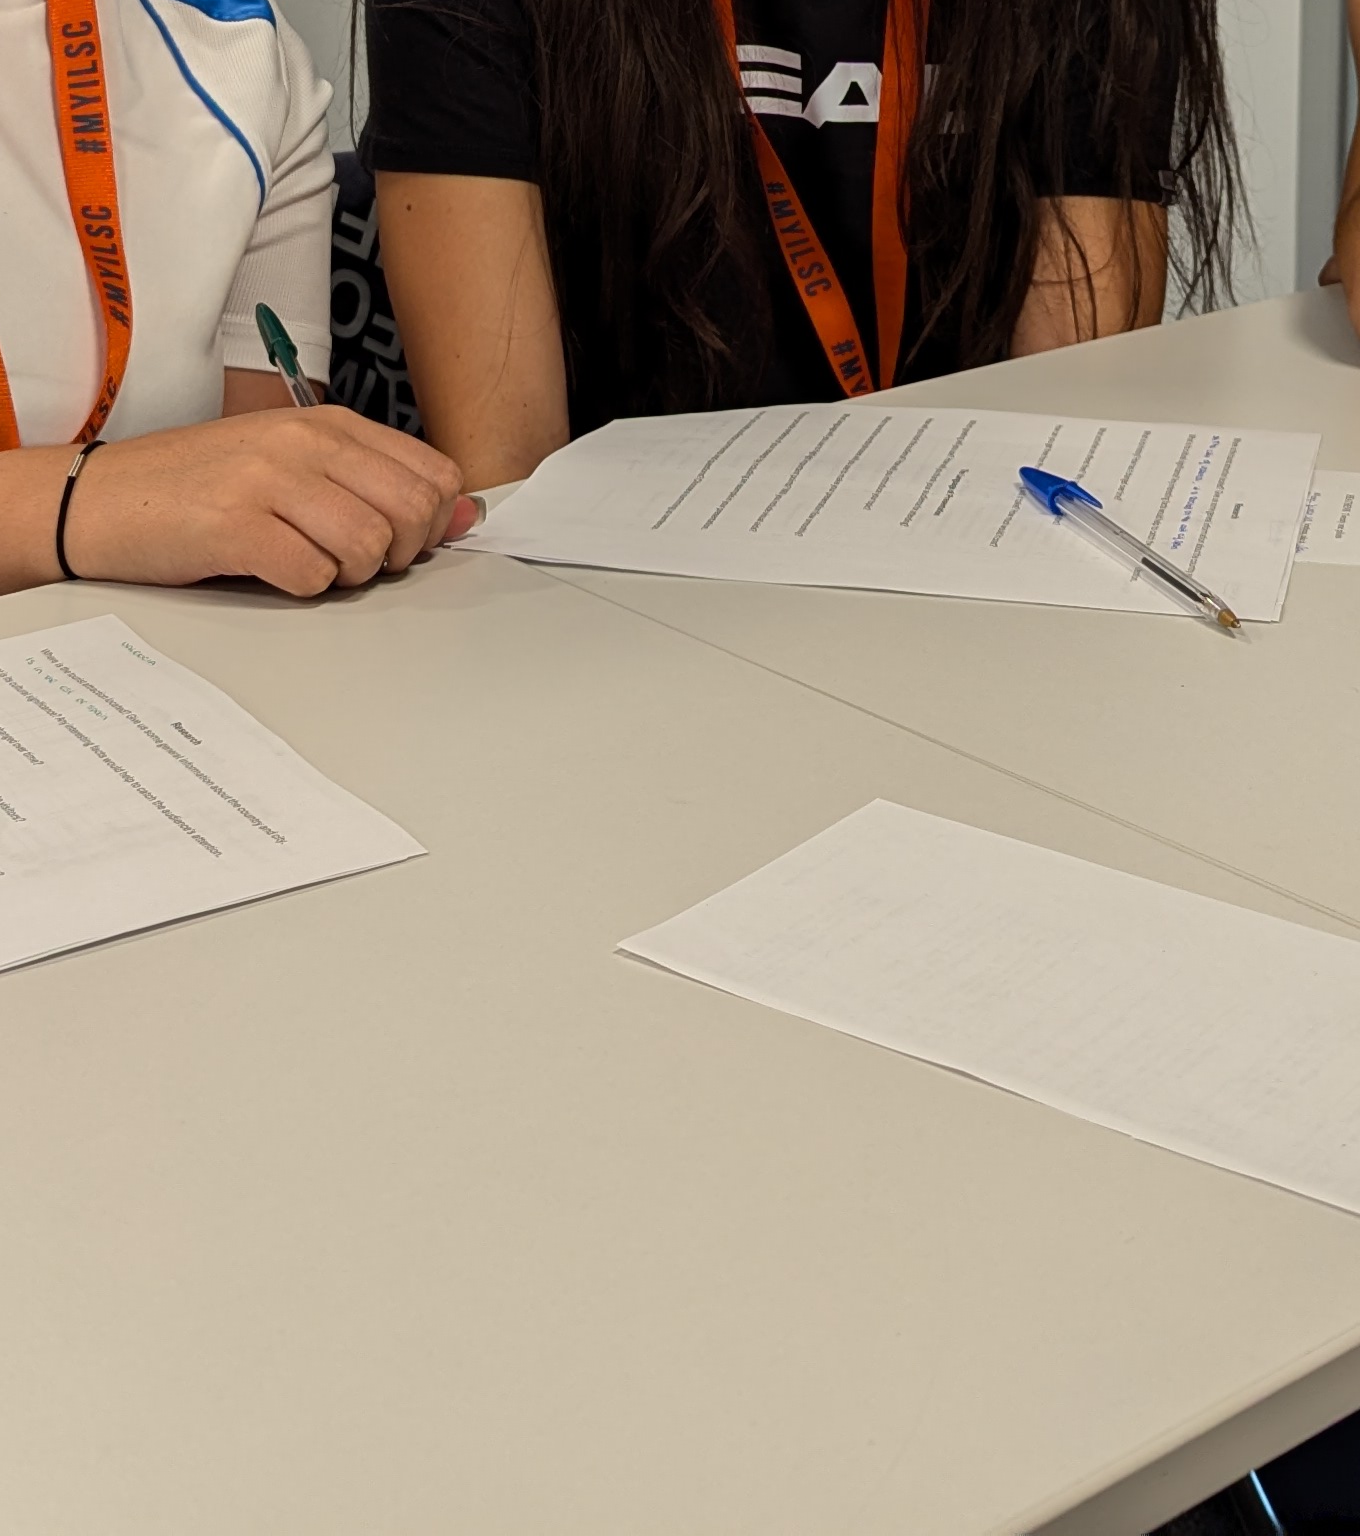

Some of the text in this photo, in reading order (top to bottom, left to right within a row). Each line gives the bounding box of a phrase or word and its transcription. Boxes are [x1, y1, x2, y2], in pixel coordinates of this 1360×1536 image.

[63, 19, 108, 156] #MYILSC
[81, 204, 130, 327] #MYILSC
[765, 180, 832, 298] #MYILSC
[169, 721, 202, 745] Research
